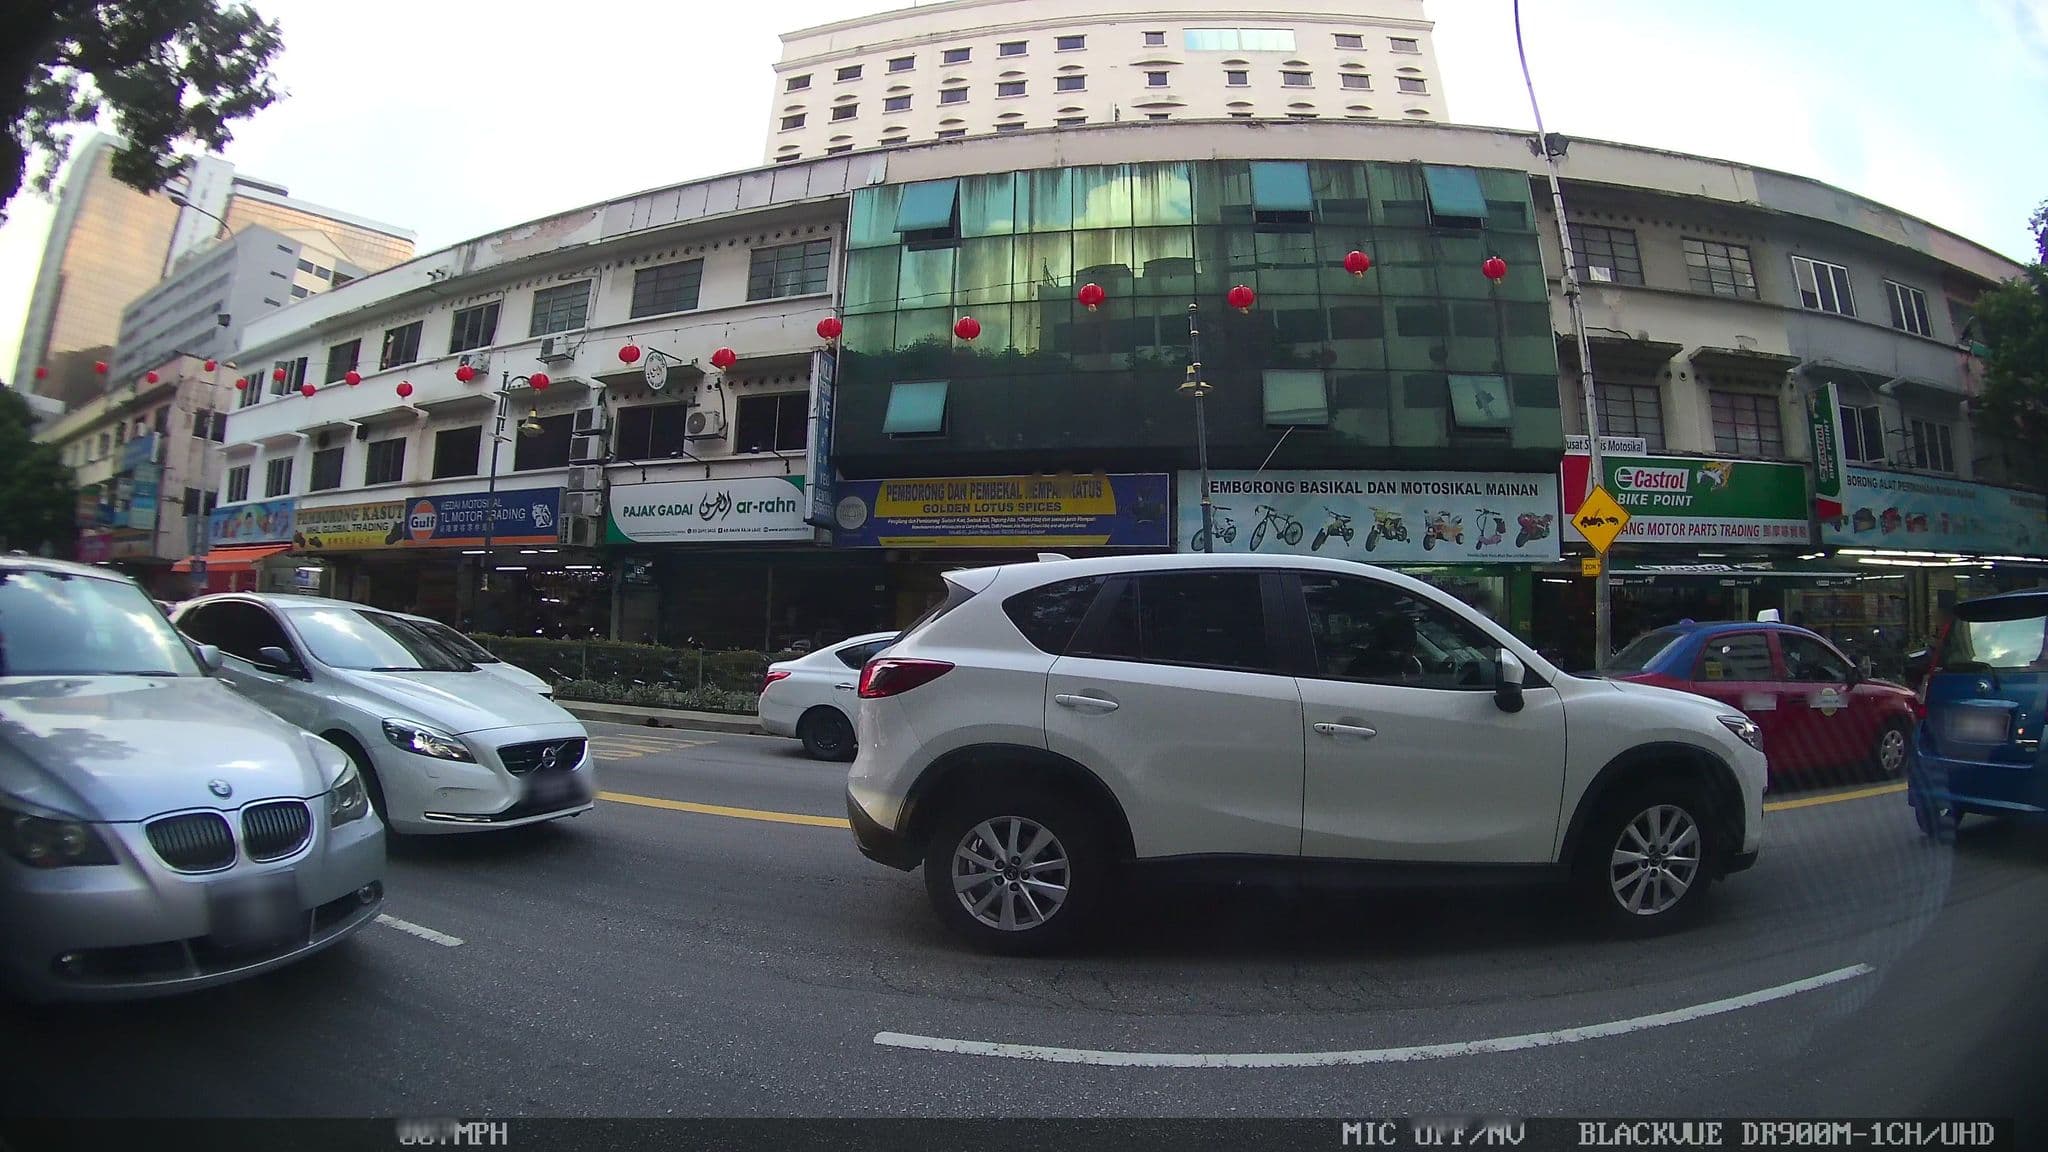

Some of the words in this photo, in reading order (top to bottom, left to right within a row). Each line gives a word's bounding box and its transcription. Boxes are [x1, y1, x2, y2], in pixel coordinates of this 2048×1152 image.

[1566, 440, 1583, 450] usat
[1585, 440, 1606, 451] Sis
[1608, 440, 1643, 452] Motosikal
[1634, 469, 1685, 489] Castrol
[886, 482, 945, 502] PEMBORONG
[948, 482, 966, 500] DAN
[970, 481, 1021, 500] PEMBEKAL
[1207, 480, 1295, 494] EMBORONG
[1300, 481, 1363, 494] BASIKAL
[1367, 481, 1397, 494] DAN
[1401, 481, 1482, 495] MOTOSIKAL
[1486, 483, 1538, 496] MAINAN
[461, 497, 503, 509] MOTOSIAL
[736, 496, 796, 514] ar-rahn
[1617, 493, 1649, 505] BIKE
[1653, 494, 1694, 506] POINT
[623, 504, 656, 518] PAJAK
[657, 503, 693, 517] GADAI
[922, 503, 970, 514] GOLDEN
[974, 502, 1014, 513] LOTUS
[1018, 501, 1061, 512] SPICES
[411, 515, 436, 529] Gulf
[451, 510, 483, 522] MOTOR
[352, 521, 390, 531] TRADING
[1620, 522, 1644, 536] ANG
[1647, 522, 1686, 536] MOTOR
[1688, 523, 1718, 537] PARTS
[1720, 523, 1760, 537] TRADING
